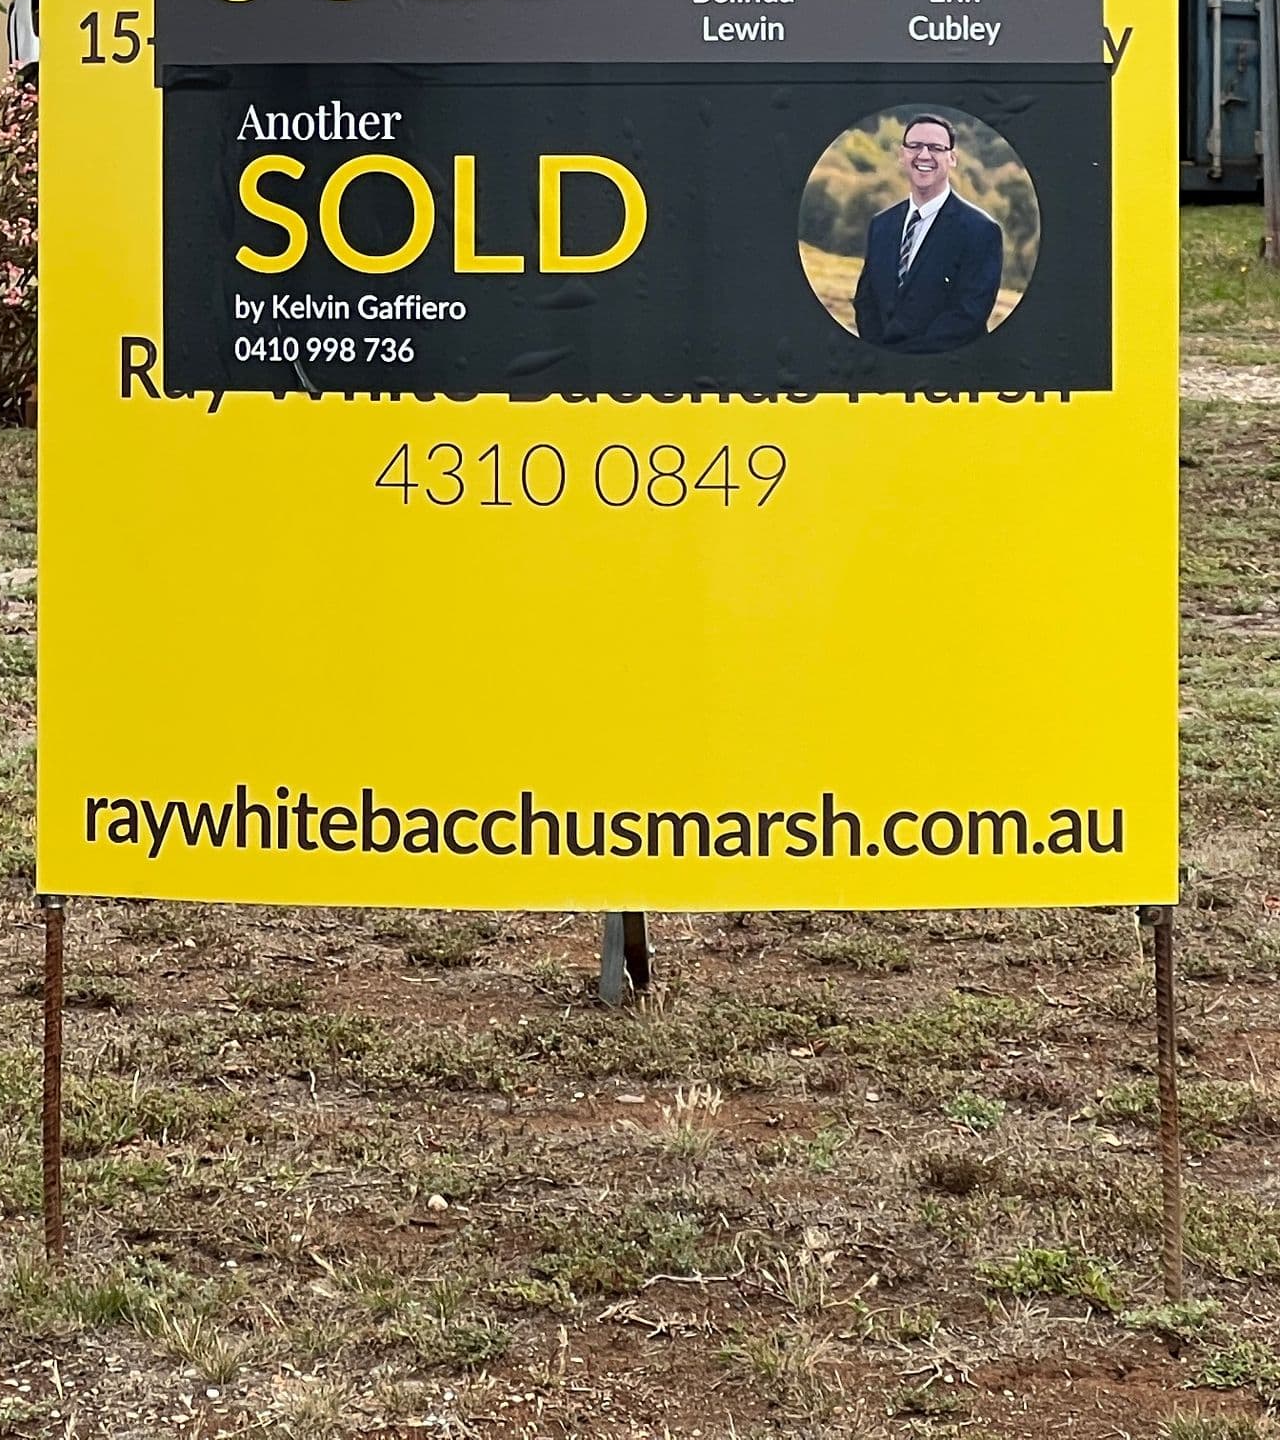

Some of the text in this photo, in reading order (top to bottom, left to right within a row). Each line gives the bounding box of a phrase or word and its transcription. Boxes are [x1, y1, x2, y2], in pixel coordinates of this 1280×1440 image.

[703, 15, 787, 43] Lewin
[908, 15, 1003, 48] Cubley
[237, 101, 404, 143] Another
[235, 154, 649, 276] SOLD
[234, 294, 468, 326] by Kelvin Gaffiero
[233, 336, 417, 365] 0410 998 736
[375, 443, 789, 509] 4310 0849
[84, 784, 1126, 860] raywhitebacchusmarsh.com.au
